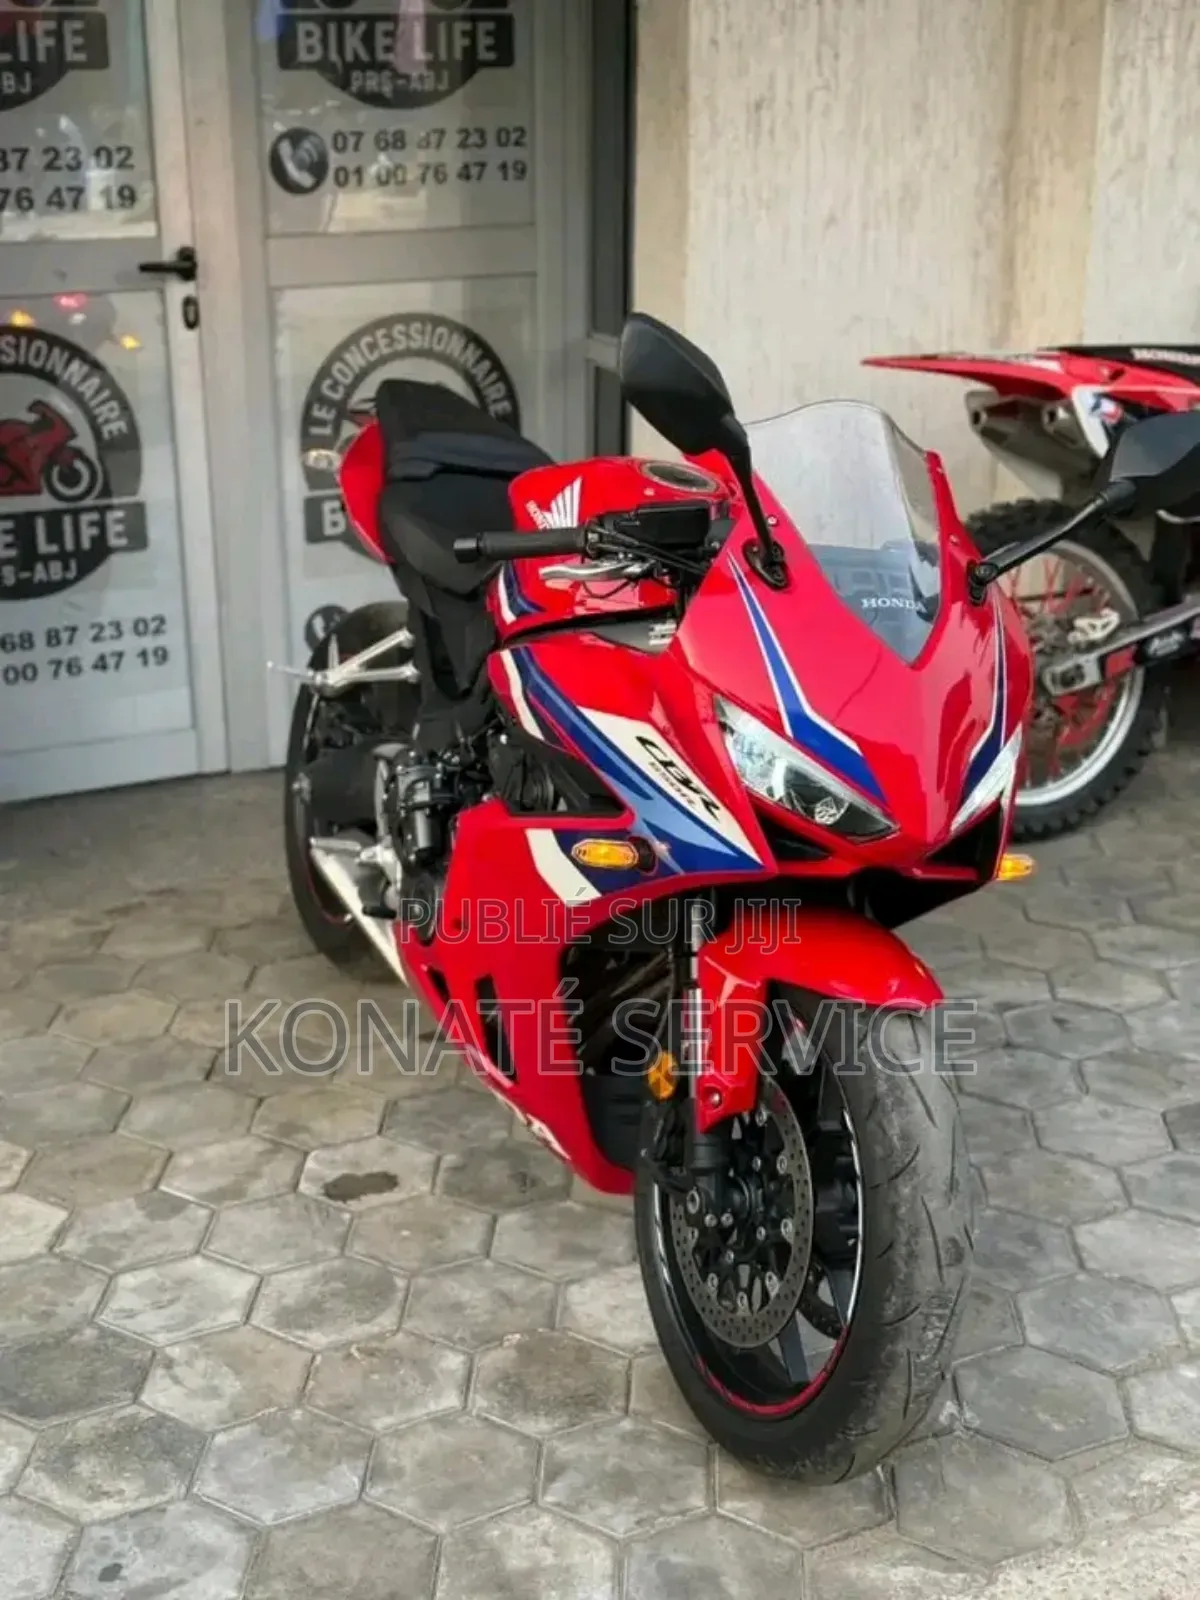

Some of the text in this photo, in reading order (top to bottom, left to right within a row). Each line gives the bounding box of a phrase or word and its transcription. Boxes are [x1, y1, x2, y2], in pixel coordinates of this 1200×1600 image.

[0, 20, 87, 63] IFE
[295, 21, 498, 63] BIKE LIFE
[42, 146, 82, 172] 23
[94, 145, 135, 171] 02
[332, 130, 364, 153] 07
[374, 128, 406, 151] 68
[456, 127, 487, 149] 23
[496, 126, 526, 148] 02
[334, 165, 363, 188] 01
[417, 161, 448, 185] 76
[457, 160, 487, 182] 47
[497, 159, 527, 181] 19
[46, 186, 84, 210] 47
[100, 184, 136, 210] 19
[309, 321, 512, 436] LE CONCESSIONNAIRE
[35, 509, 128, 555] LIFE
[861, 597, 928, 613] HONDA
[0, 613, 166, 653] 68 87 23 02
[3, 646, 168, 685] 00 76 47 19
